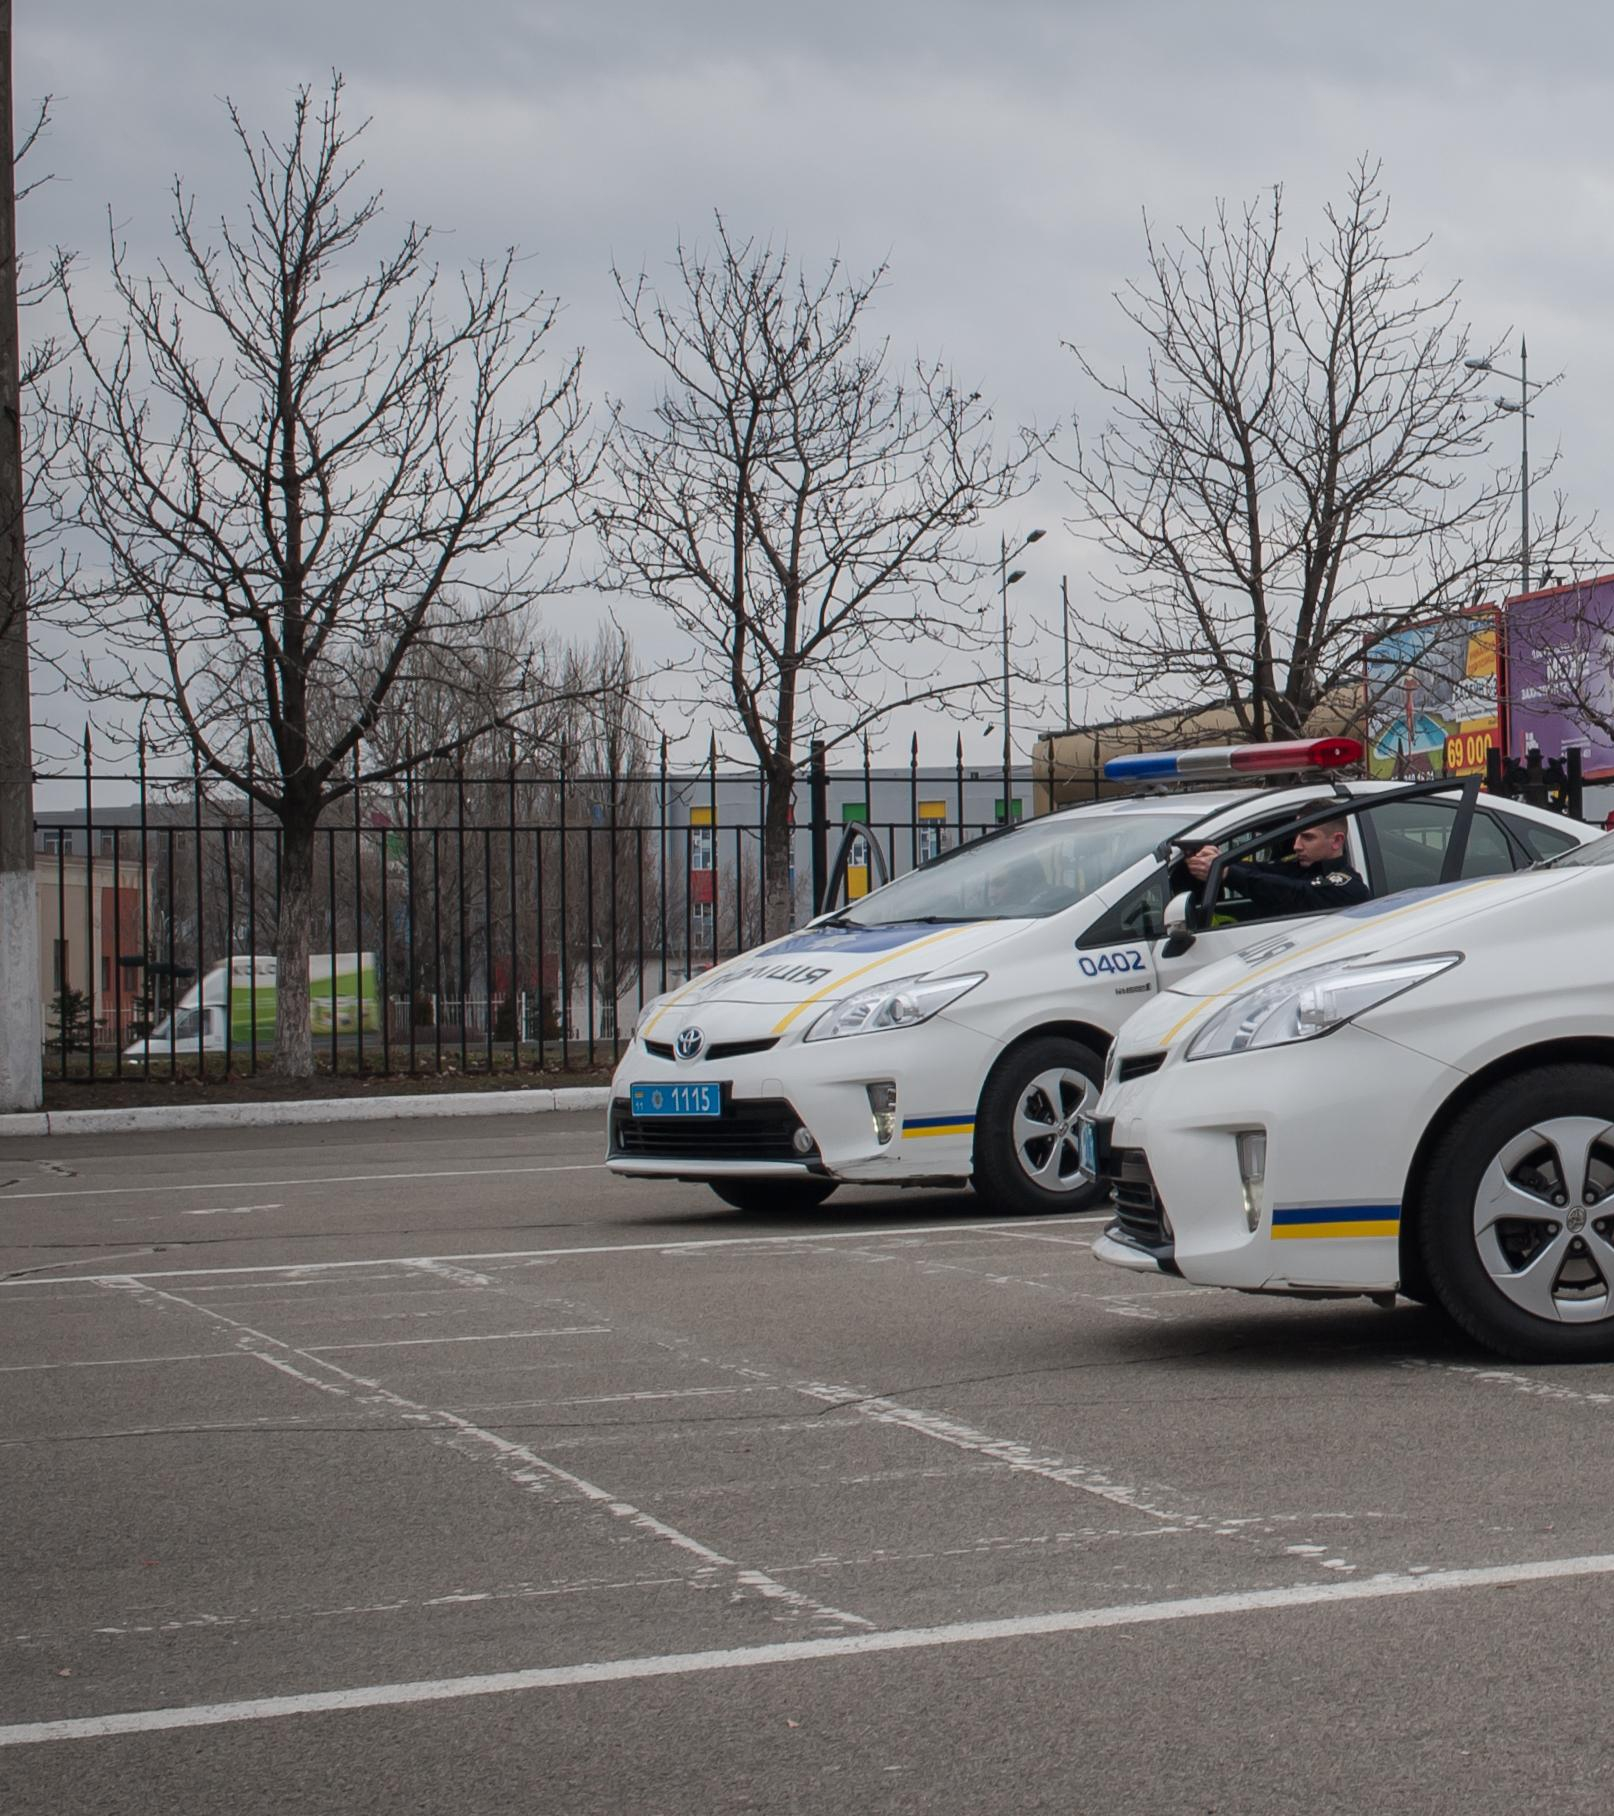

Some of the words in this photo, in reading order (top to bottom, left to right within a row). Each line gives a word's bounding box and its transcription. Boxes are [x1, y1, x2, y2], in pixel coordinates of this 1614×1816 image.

[1447, 738, 1464, 769] 69
[1078, 950, 1146, 977] 0402
[671, 1086, 711, 1112] 1115
